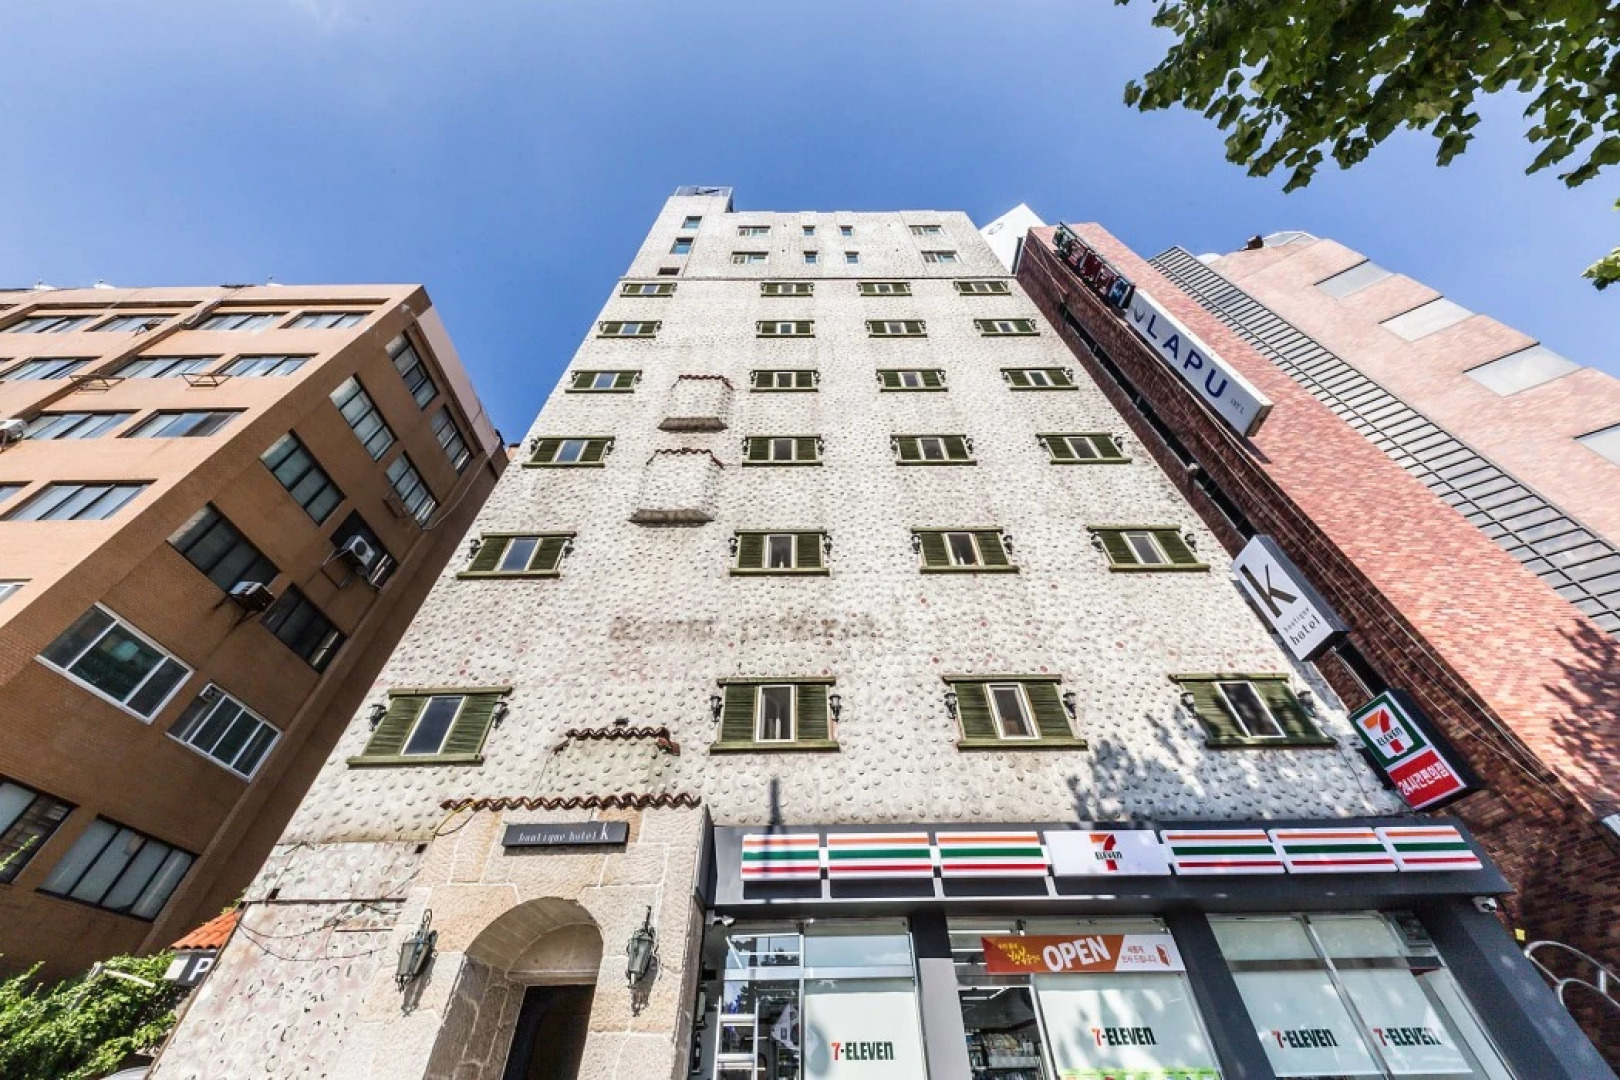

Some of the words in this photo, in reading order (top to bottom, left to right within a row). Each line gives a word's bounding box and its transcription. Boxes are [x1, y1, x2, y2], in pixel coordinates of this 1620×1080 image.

[1147, 314, 1228, 398] LAPU
[1290, 613, 1321, 646] hotel
[1363, 709, 1405, 754] 7
[518, 832, 565, 844] boutique
[569, 831, 597, 841] hotel
[1089, 833, 1118, 871] 7
[1042, 935, 1112, 972] OPEN
[831, 1041, 895, 1061] 7-ELEVEN
[1092, 1027, 1157, 1047] 7-ELEVEN
[1271, 1028, 1339, 1049] 7-ELEVEN
